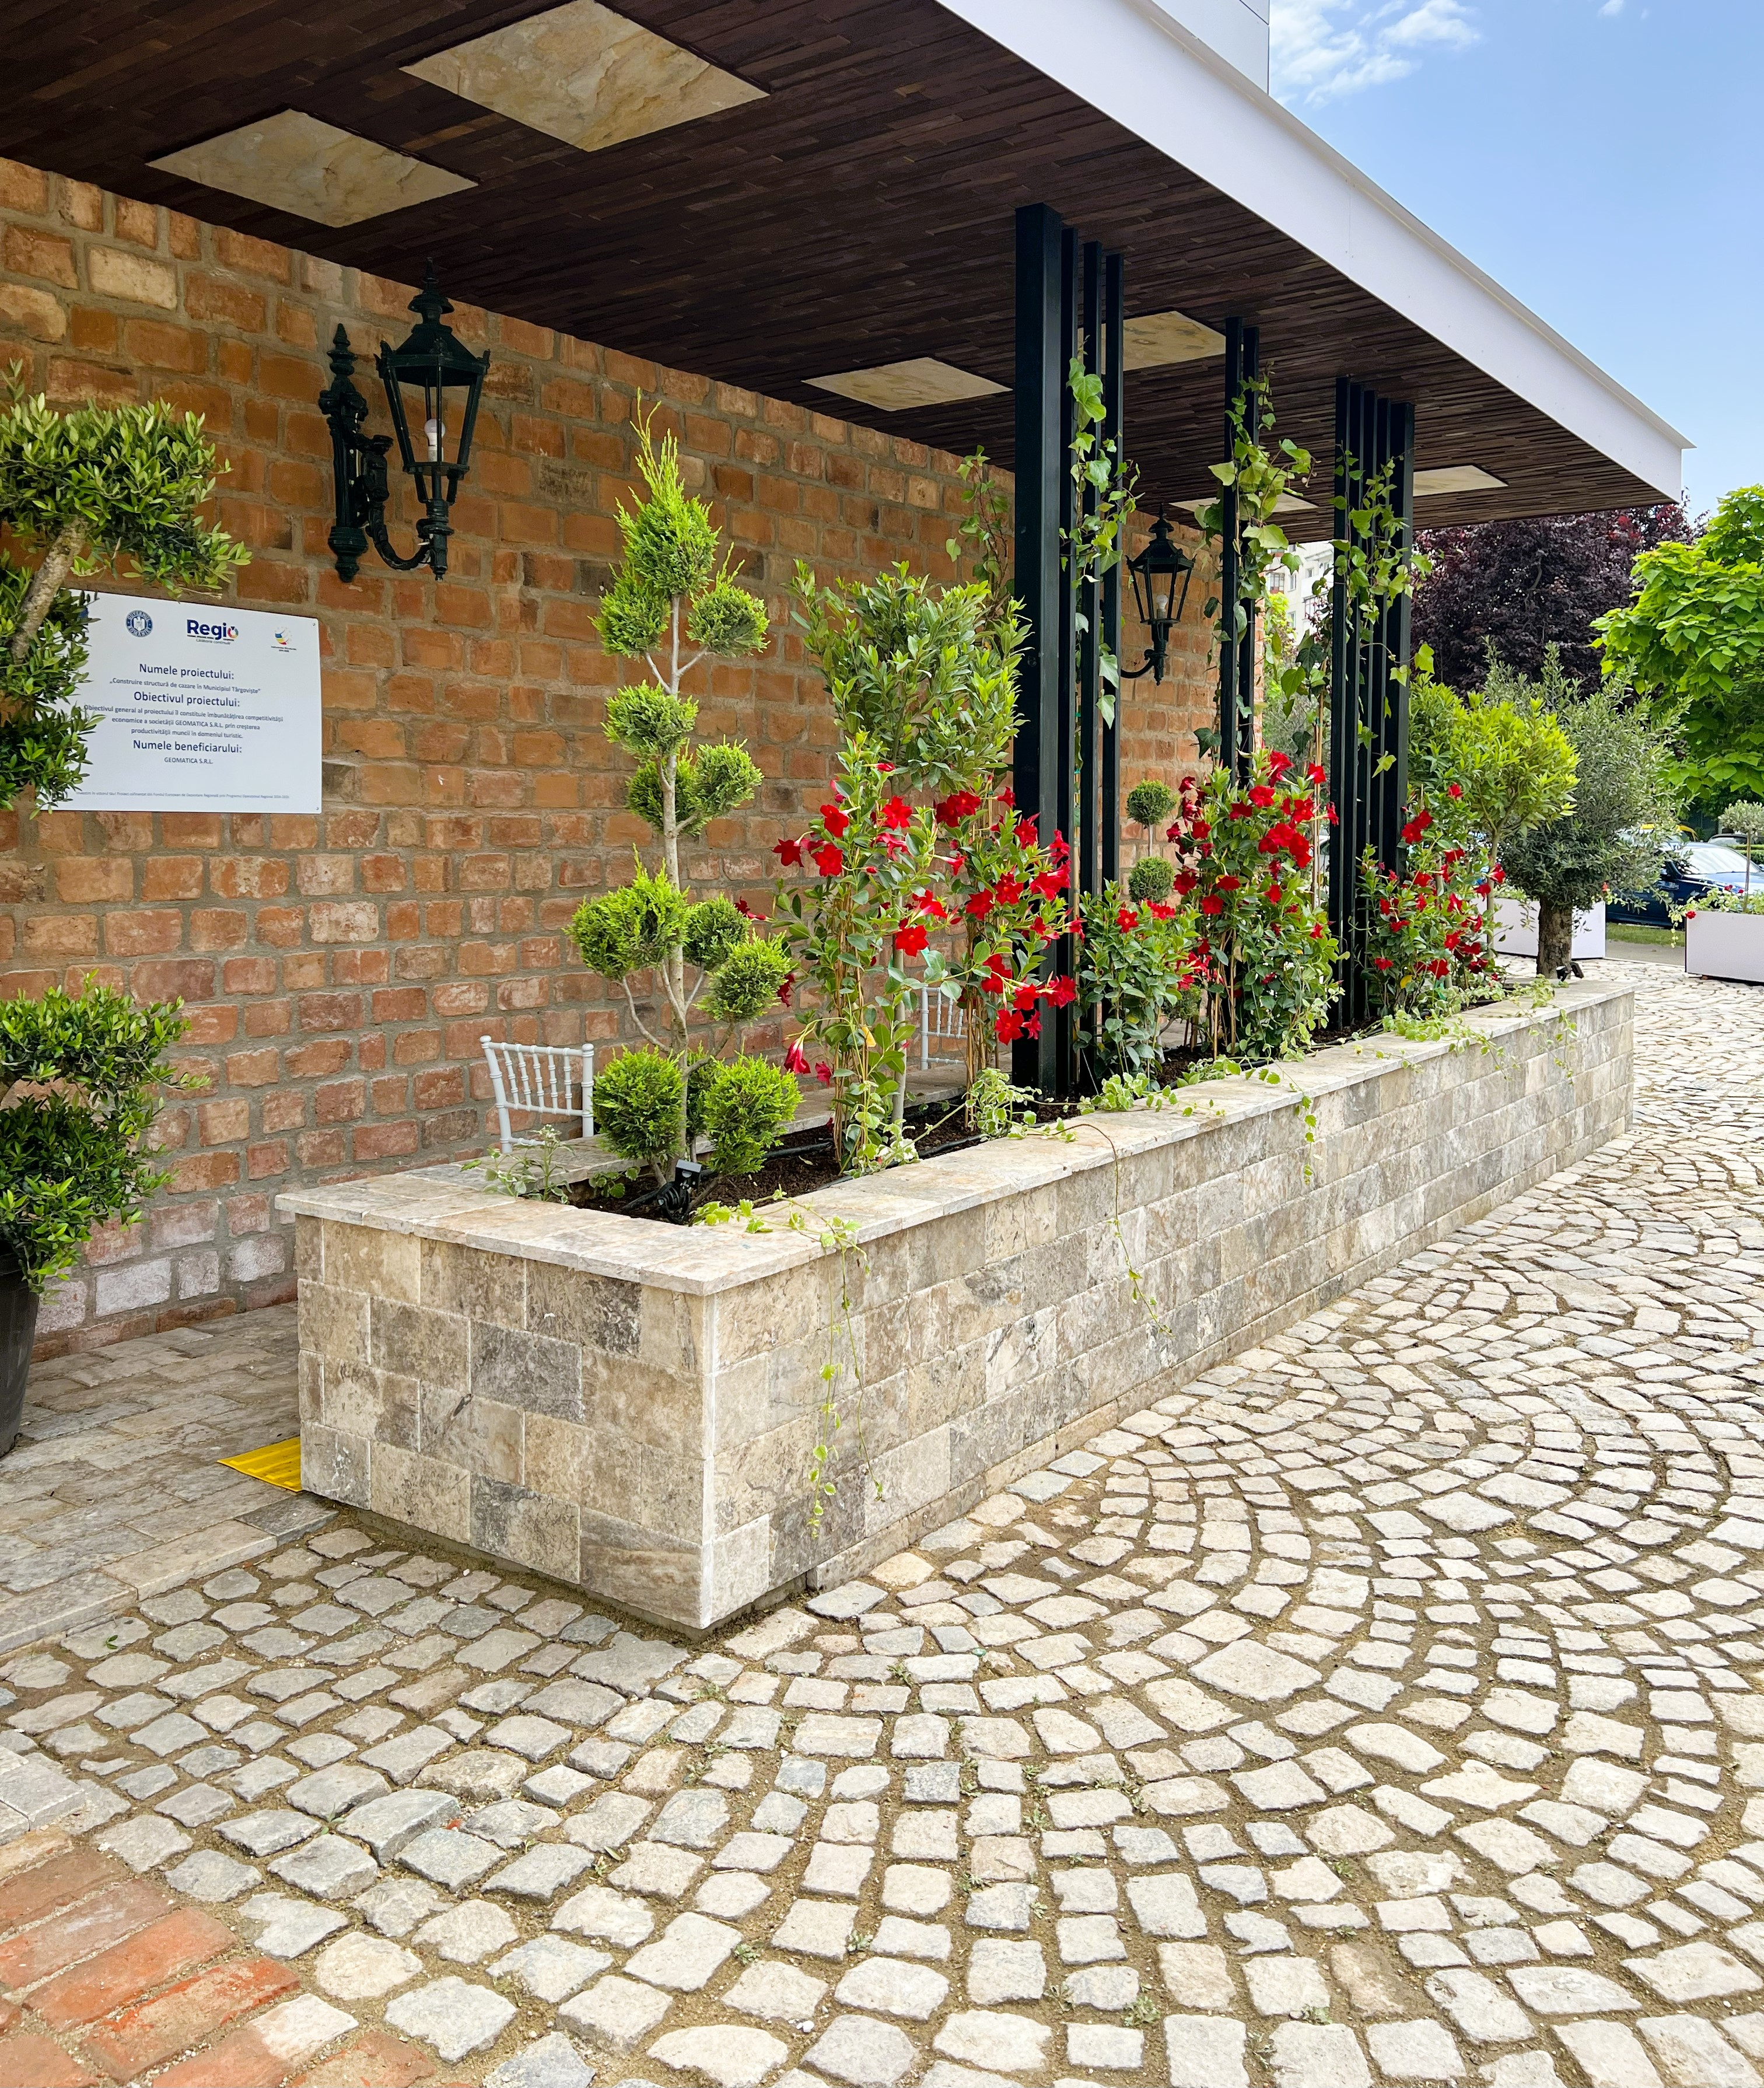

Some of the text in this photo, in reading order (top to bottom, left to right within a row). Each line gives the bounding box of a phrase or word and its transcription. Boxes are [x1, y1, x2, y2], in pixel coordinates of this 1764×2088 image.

[140, 664, 235, 679] Numele proiectului:
[144, 679, 169, 687] structură
[134, 691, 240, 707] Obiectivul proiectului:
[133, 740, 242, 753] Numele beneficiarului:
